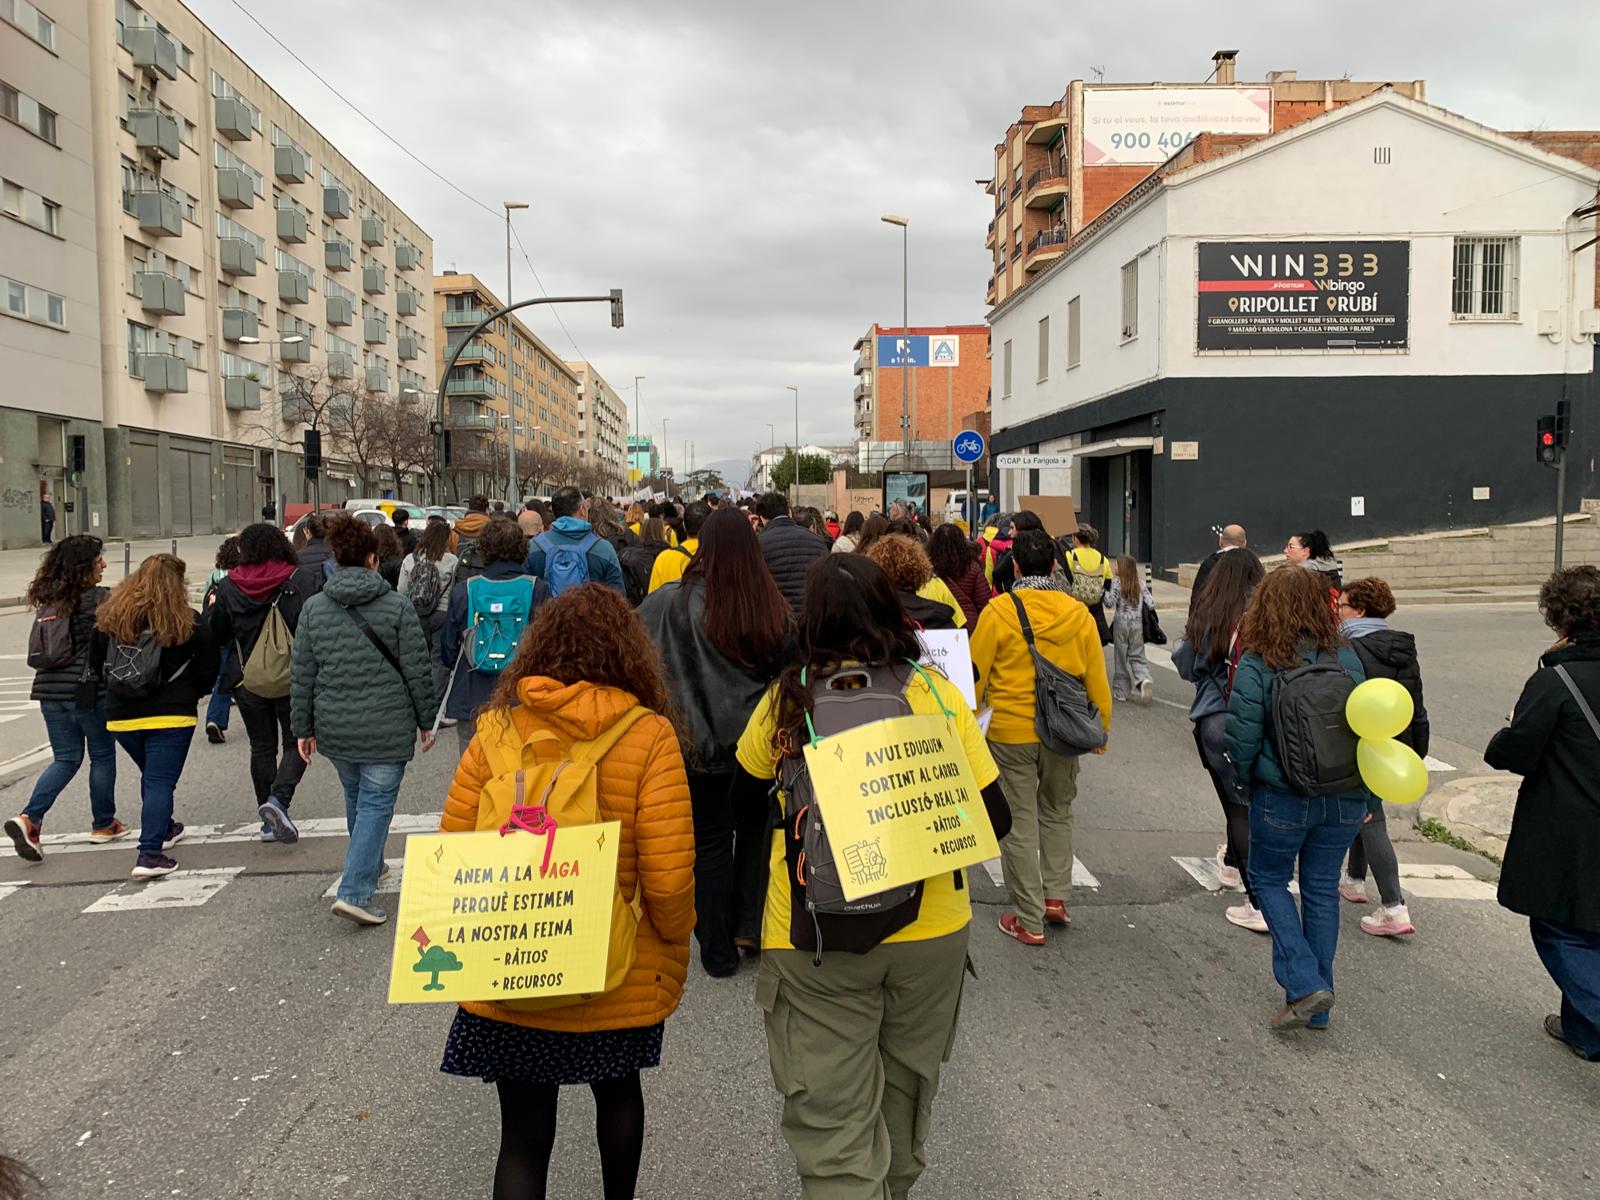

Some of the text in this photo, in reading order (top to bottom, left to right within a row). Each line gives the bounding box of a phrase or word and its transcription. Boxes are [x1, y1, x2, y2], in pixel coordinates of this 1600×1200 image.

[1092, 116, 1101, 125] Si
[1102, 117, 1112, 125] tu
[1114, 116, 1123, 125] el
[1124, 116, 1148, 126] veus,
[1150, 116, 1158, 124] la
[1161, 116, 1181, 124] teva
[1231, 115, 1242, 123] ho
[1111, 132, 1151, 150] 900
[1239, 292, 1378, 313] RIPOLLET RUBÍ
[1212, 317, 1248, 325] GRANOLLERS
[1254, 317, 1275, 325] PARETS
[1232, 325, 1257, 333] MATARÓ
[1007, 457, 1021, 465] CAP
[1033, 457, 1059, 466] Farigola
[865, 737, 945, 768] AVUI EDUQUEM
[859, 762, 961, 797] SORTINT AL CARRER
[934, 793, 956, 808] REAL
[957, 787, 969, 804] JA!
[934, 815, 962, 834] RÀTIOS
[941, 834, 977, 856] RECURSOS
[453, 866, 494, 886] ANEM
[499, 866, 510, 884] A
[515, 865, 532, 882] LA
[452, 890, 574, 914] PERQUÈ ESTIMEM
[447, 919, 574, 944] LA NOSTRA FEINA
[504, 947, 549, 966] RÀTIOS
[503, 972, 564, 991] RECURSOS
